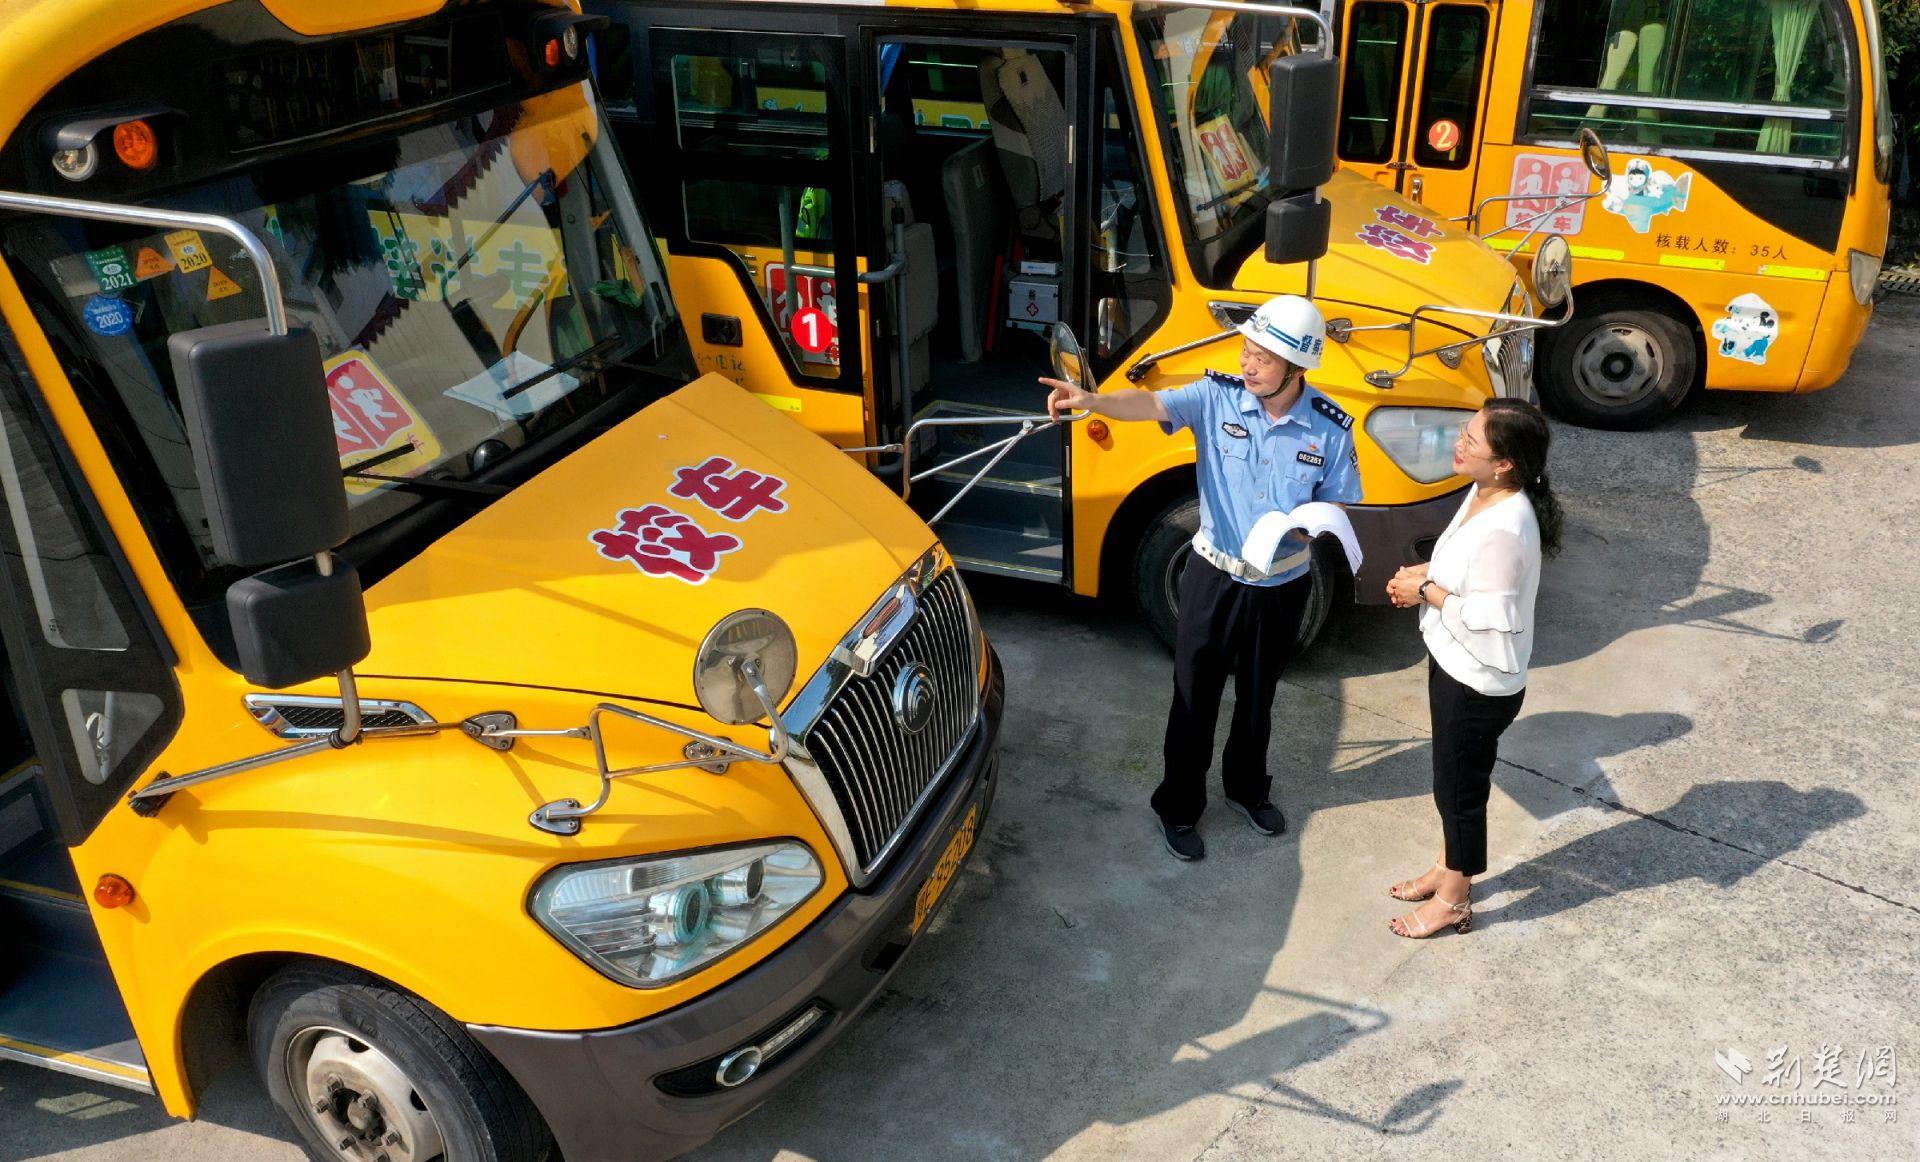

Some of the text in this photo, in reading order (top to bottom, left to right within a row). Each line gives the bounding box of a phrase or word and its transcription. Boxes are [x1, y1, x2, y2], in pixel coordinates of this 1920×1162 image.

[1436, 122, 1451, 147] 2
[1750, 244, 1787, 260] 35人
[181, 253, 208, 271] 2020
[101, 273, 134, 291] 2021
[96, 311, 124, 329] 2020
[801, 313, 818, 348] 1
